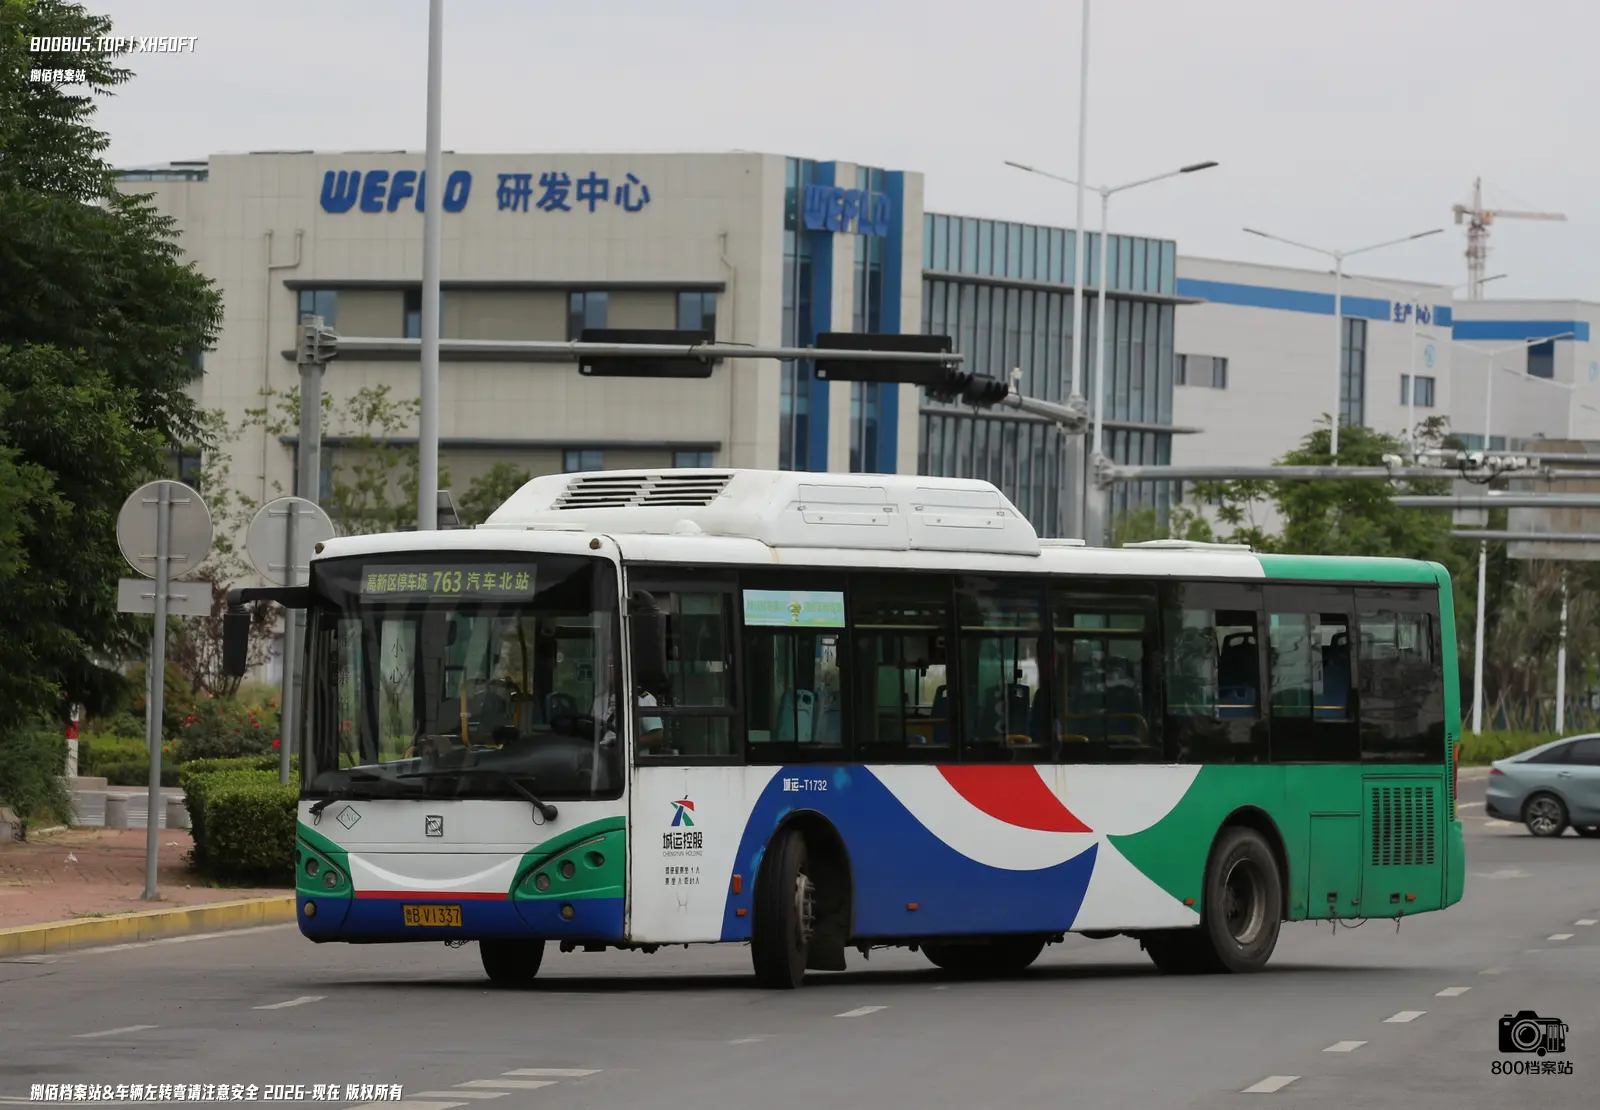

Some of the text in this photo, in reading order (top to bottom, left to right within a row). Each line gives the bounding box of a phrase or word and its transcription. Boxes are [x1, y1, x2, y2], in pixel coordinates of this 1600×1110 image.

[496, 171, 650, 212] 研发中心
[803, 184, 892, 238] WEFLO
[367, 571, 529, 594] 高新区停车场 763 汽车北站
[662, 831, 703, 850] 城运控股
